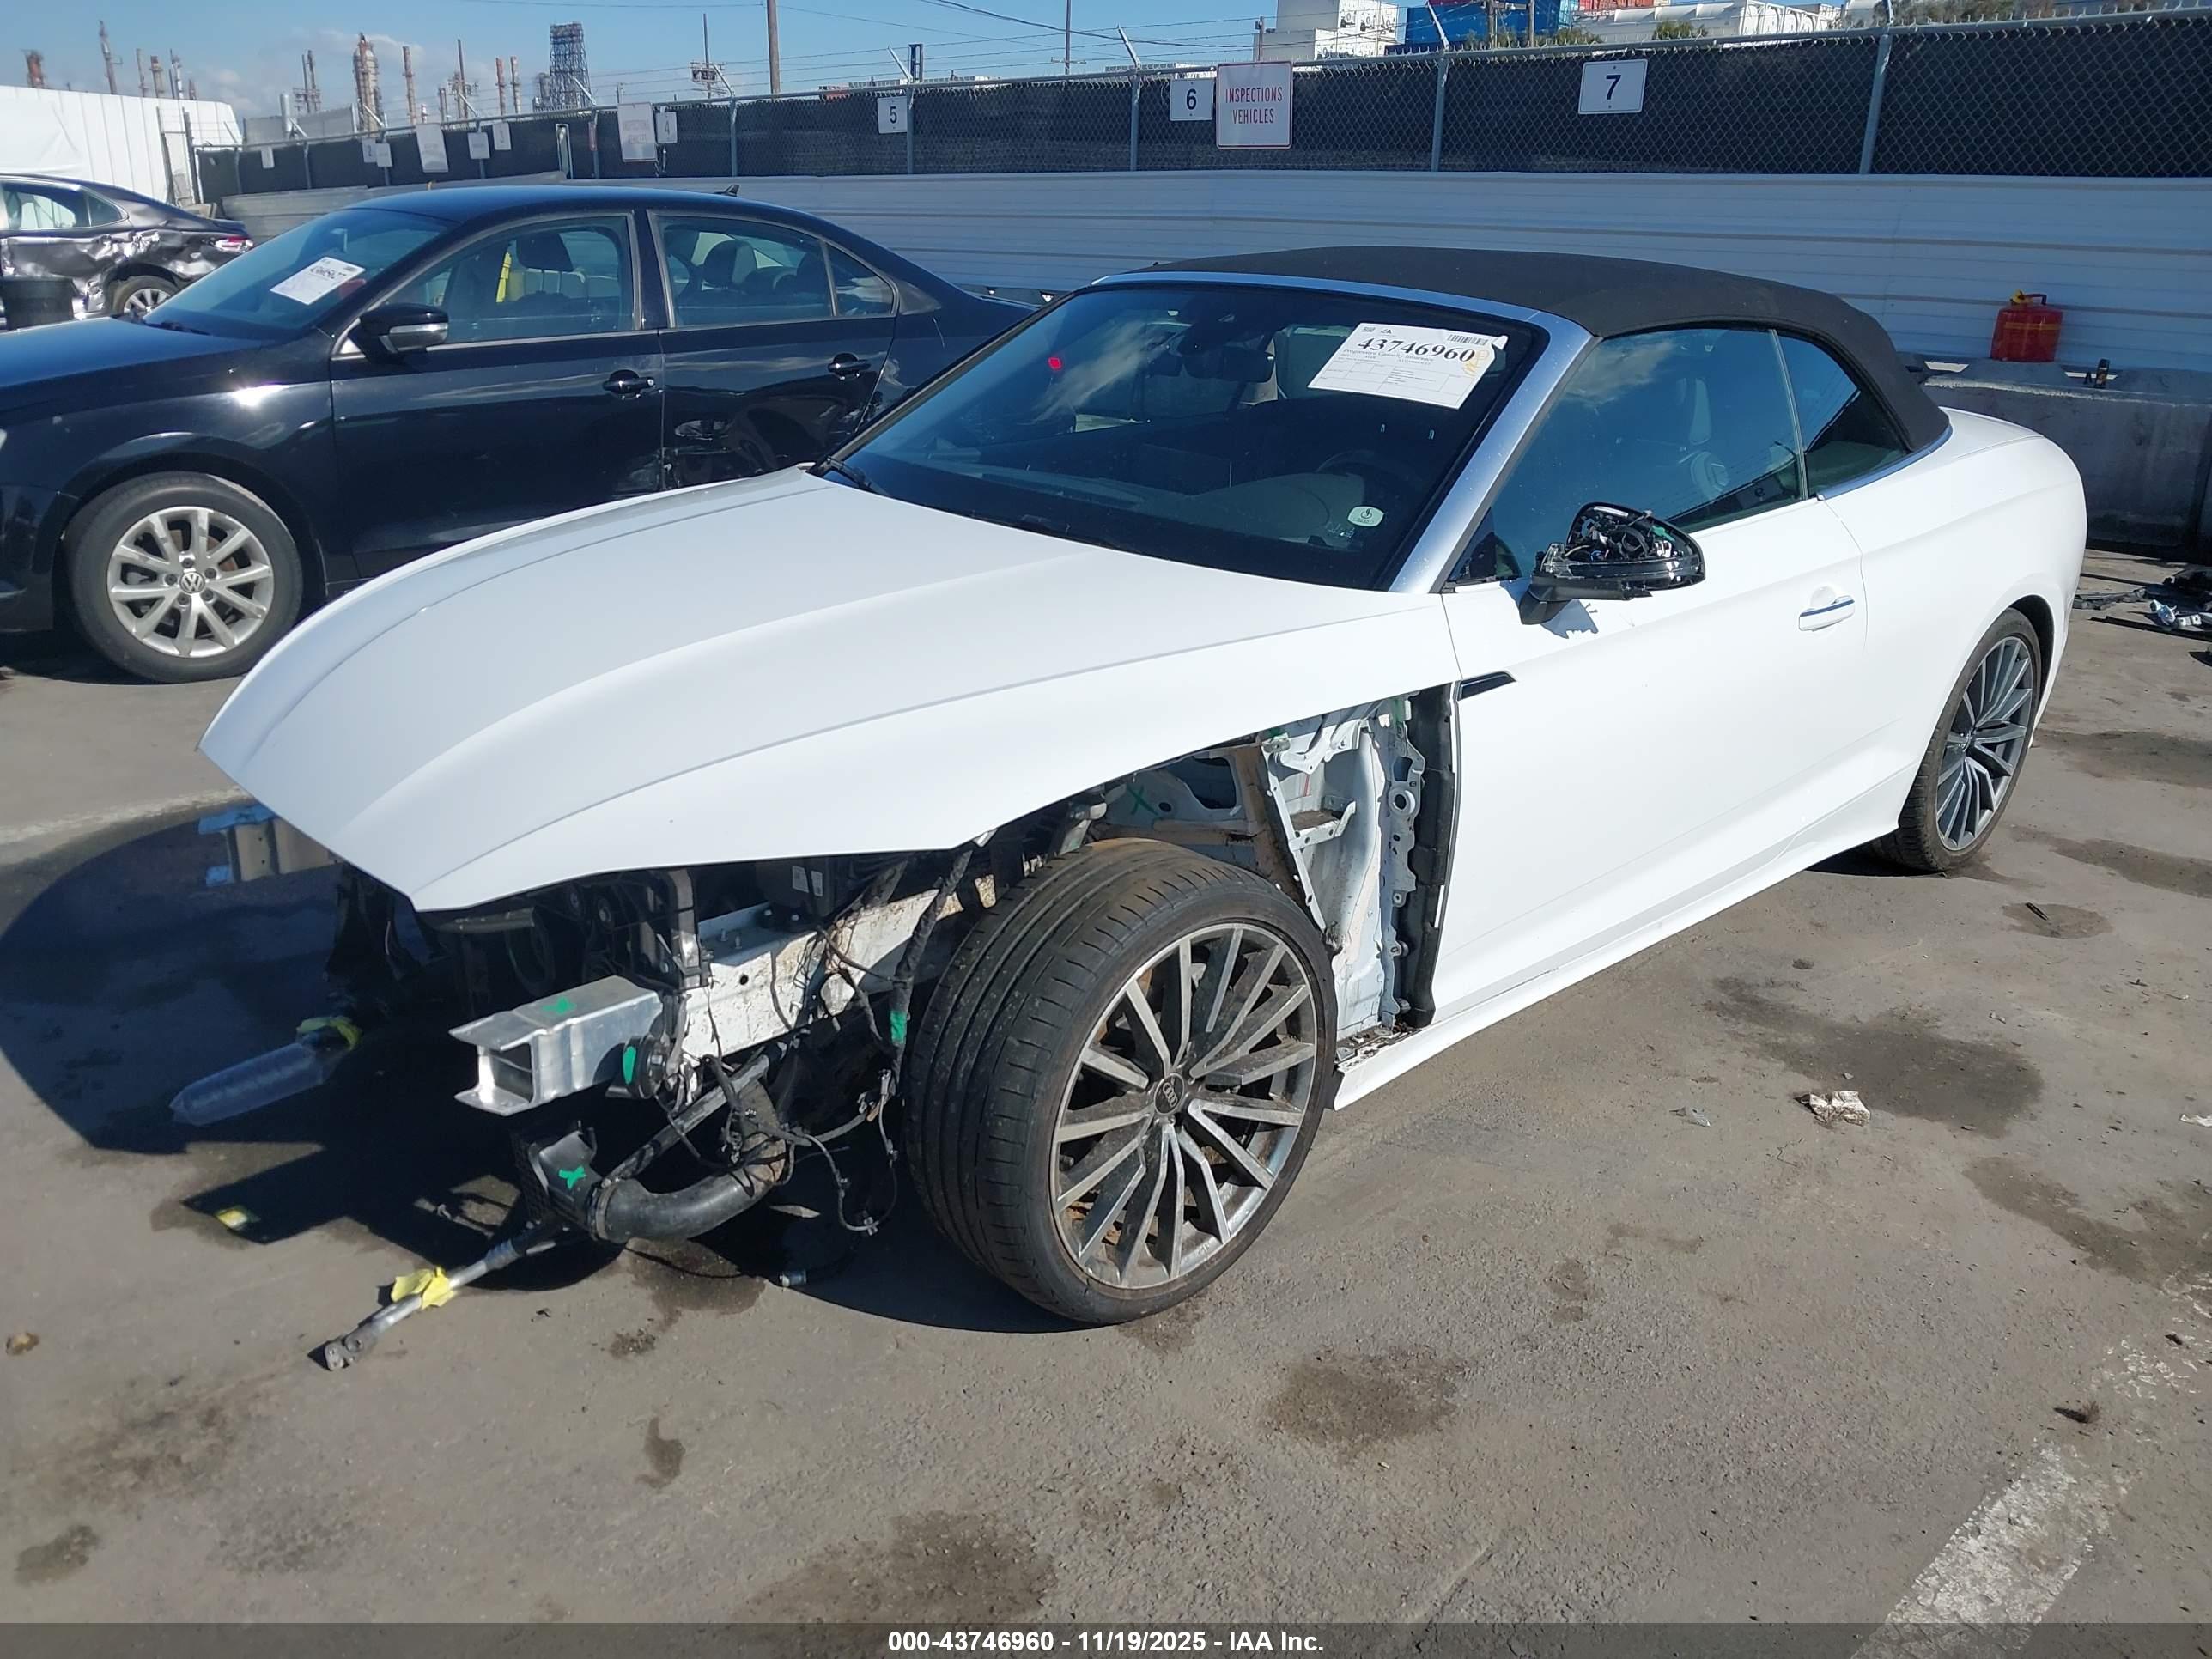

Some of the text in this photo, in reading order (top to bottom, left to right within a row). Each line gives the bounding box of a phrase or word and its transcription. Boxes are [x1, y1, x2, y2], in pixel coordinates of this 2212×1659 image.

[1225, 87, 1283, 103] INSPECTIONS
[1606, 74, 1622, 100] 7
[1186, 88, 1197, 110] 6
[890, 106, 897, 124] 5
[1232, 108, 1274, 125] VEHICLES
[665, 120, 671, 135] 4
[1358, 337, 1475, 362] 43746960
